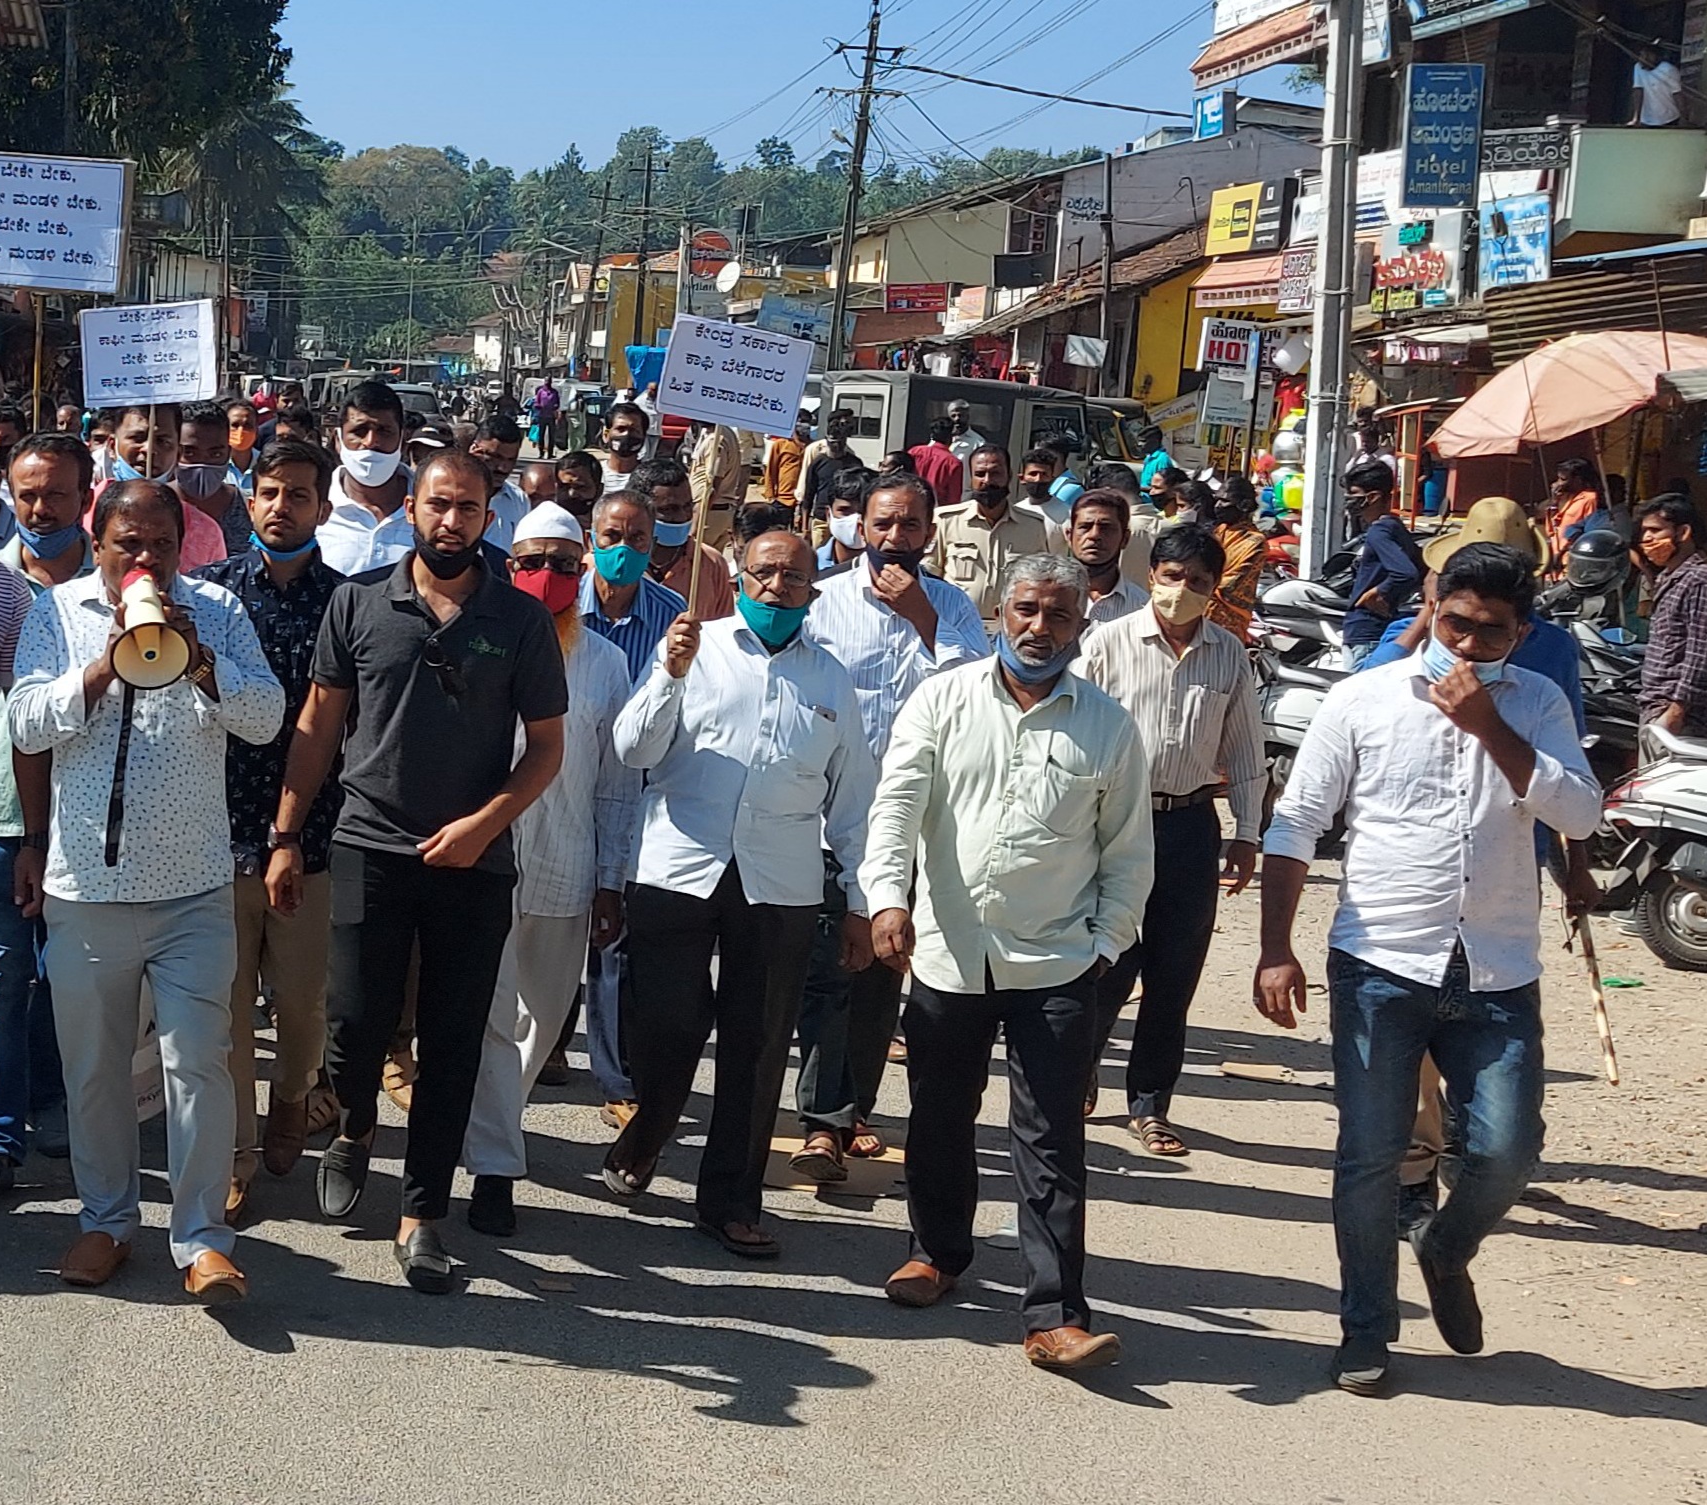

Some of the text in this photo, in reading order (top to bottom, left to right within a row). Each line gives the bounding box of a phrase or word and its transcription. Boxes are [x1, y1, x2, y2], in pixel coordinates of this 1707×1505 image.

[1413, 86, 1478, 113] ಹೋಟೆಲ್
[1, 162, 33, 179] ಬೇಕೇ
[1416, 159, 1467, 174] Hotel
[13, 193, 59, 207] ಮಂಡಳಿ
[9, 247, 56, 261] ಮಂಡಳಿ
[119, 311, 146, 322] ಬೇಕೇ
[131, 331, 168, 343] ಮಂಡಳಿ
[696, 323, 790, 355] ಕೇಂದ್ರ ಸರ್ಕಾರ
[121, 353, 148, 364] ಬೇಕೇ
[721, 358, 785, 383] ಬೆಳೆಗಾರರ
[133, 373, 170, 385] ಮಂಡಳಿ
[669, 376, 694, 394] ಹಿತ
